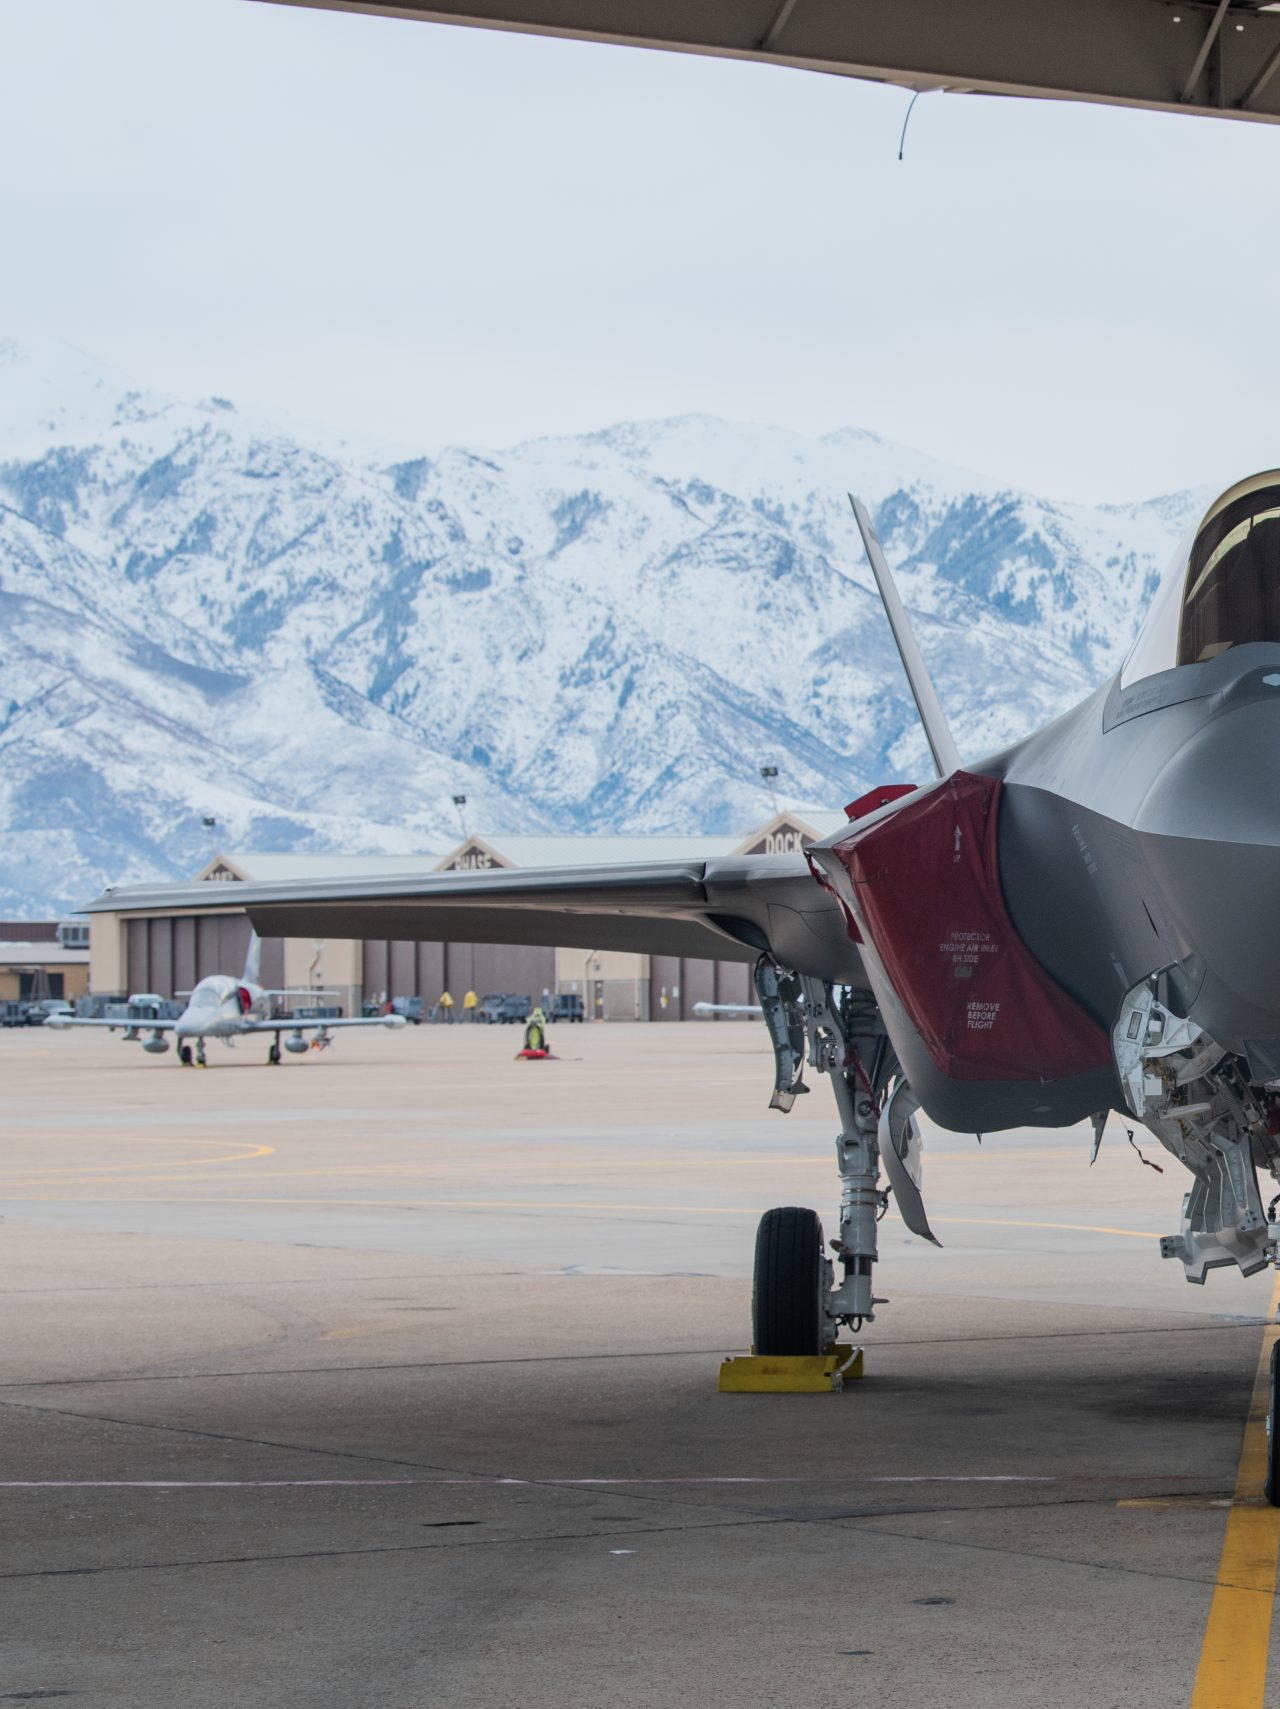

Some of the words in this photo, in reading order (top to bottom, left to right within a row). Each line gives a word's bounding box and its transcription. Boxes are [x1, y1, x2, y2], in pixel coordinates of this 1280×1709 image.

[765, 832, 803, 854] DOCK
[455, 854, 491, 869] PHASE
[951, 932, 990, 941] PROTECTOR
[940, 943, 966, 952] ENGINE
[966, 943, 979, 952] AIR
[963, 954, 980, 963] SIDE
[967, 1002, 1000, 1011] REMOVE
[967, 1011, 997, 1020] BEFORE
[967, 1020, 993, 1030] FLIGHT
